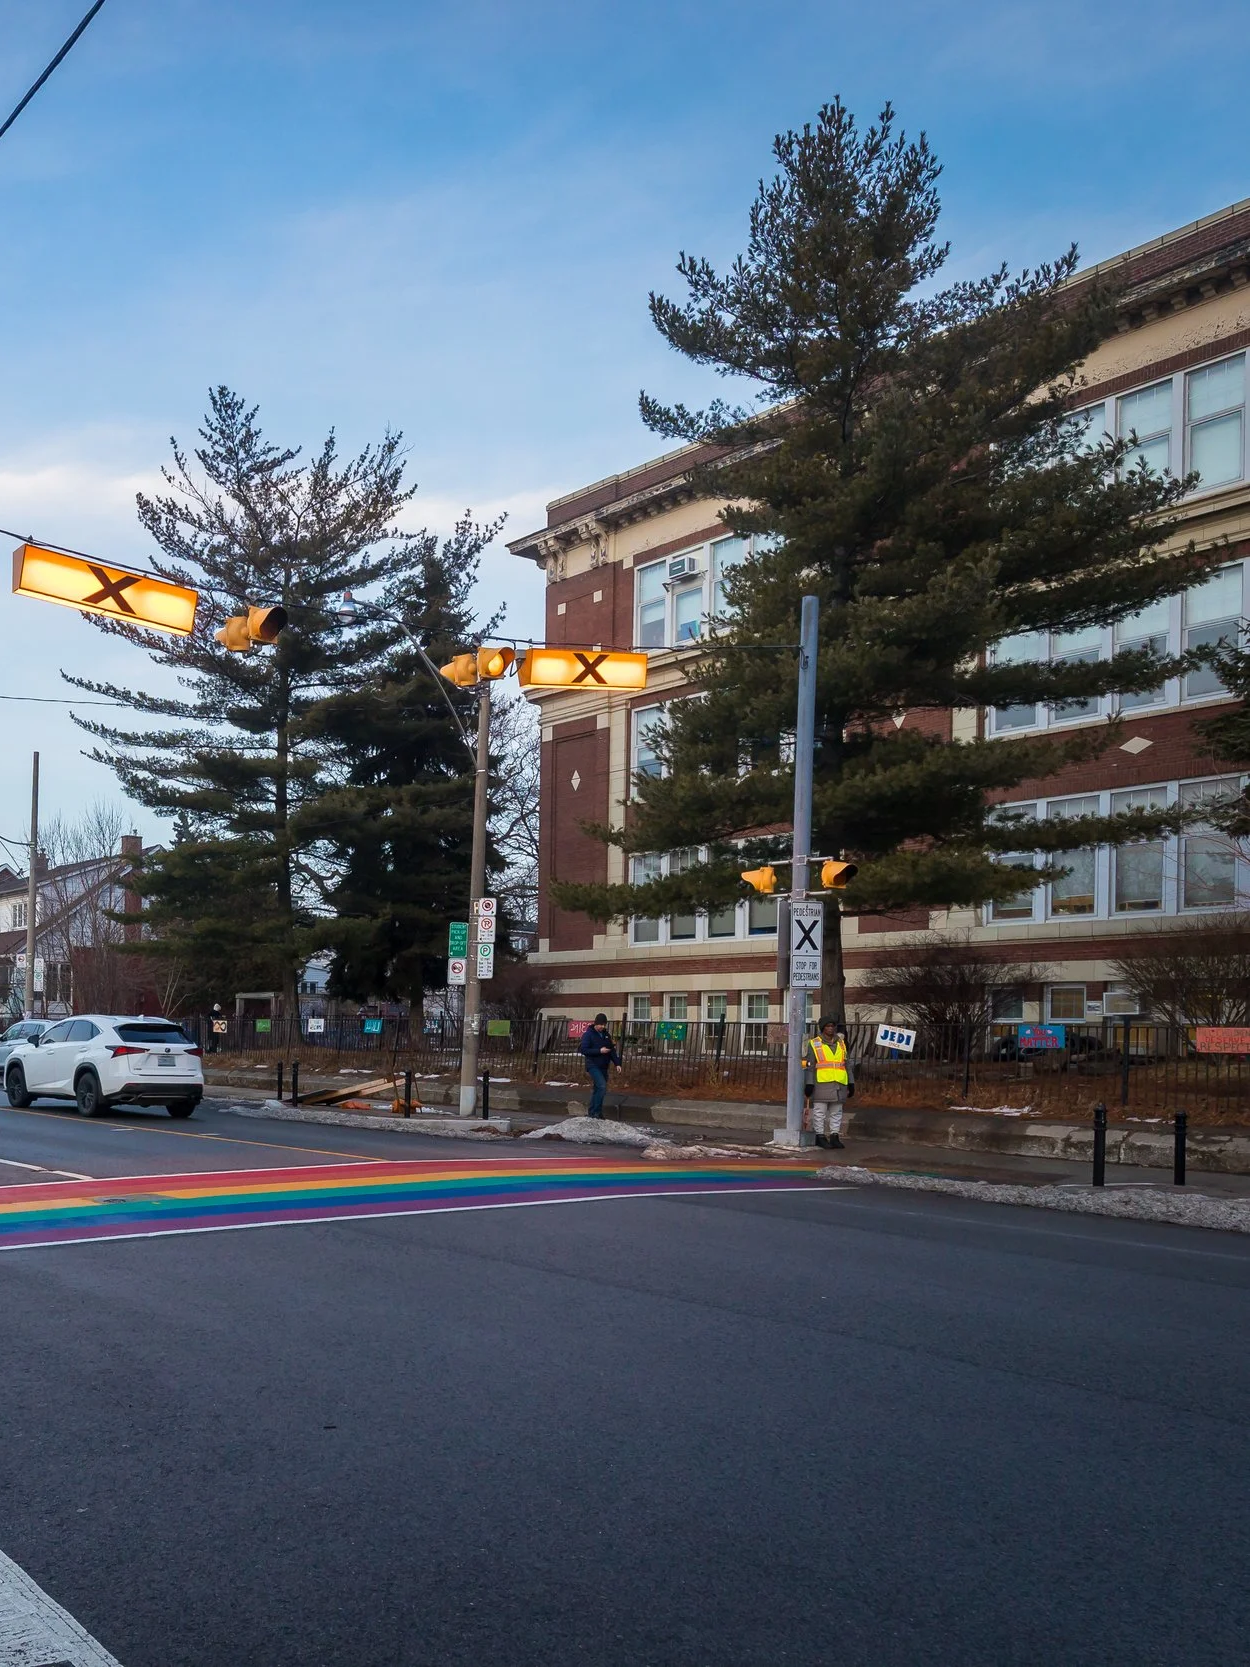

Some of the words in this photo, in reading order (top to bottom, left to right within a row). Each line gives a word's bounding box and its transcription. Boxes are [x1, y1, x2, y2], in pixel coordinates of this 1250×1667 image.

[793, 907, 821, 917] PEDESTRIAN
[795, 962, 807, 970] STOP
[809, 962, 818, 970] FOR
[792, 972, 820, 981] PEDESTRIANS
[1031, 1025, 1048, 1037] YOU
[880, 1029, 912, 1046] JEDI
[1020, 1036, 1060, 1048] MATTER
